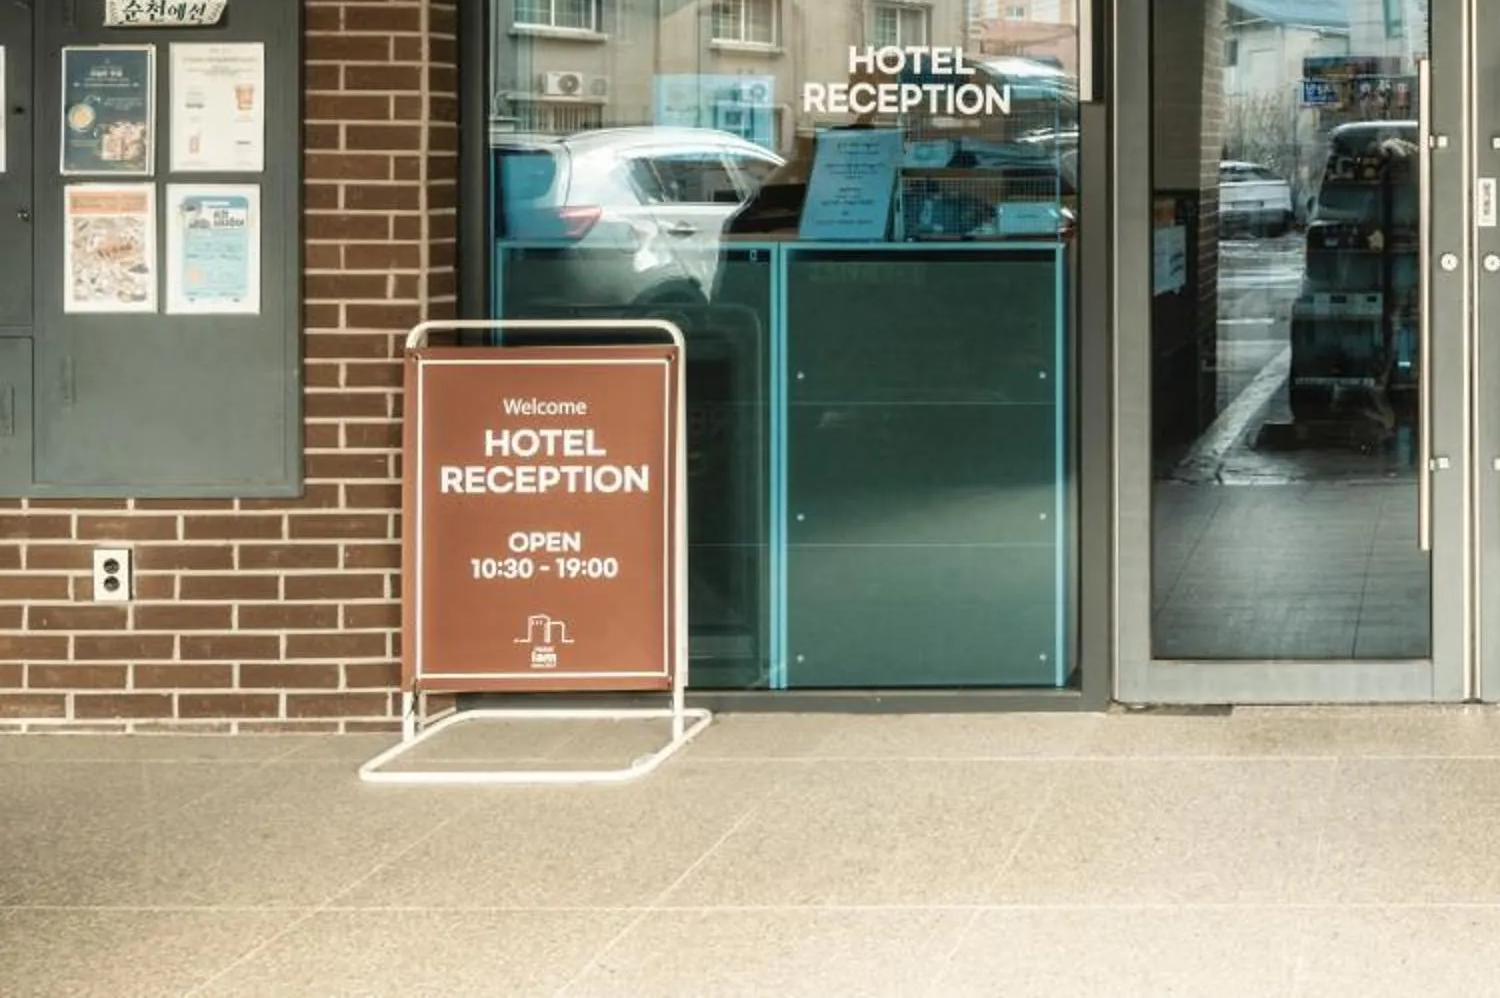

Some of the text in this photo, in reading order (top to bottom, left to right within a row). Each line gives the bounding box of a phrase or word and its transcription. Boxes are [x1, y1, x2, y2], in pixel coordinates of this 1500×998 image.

[849, 45, 975, 75] HOTEL
[802, 82, 1012, 115] RECEPTION
[503, 397, 588, 416] Welcome
[484, 428, 606, 457] HOTEL
[440, 465, 650, 494] RECEPTION
[508, 532, 581, 552] OPEN
[471, 559, 533, 578] 10:30
[556, 558, 618, 578] 19:00
